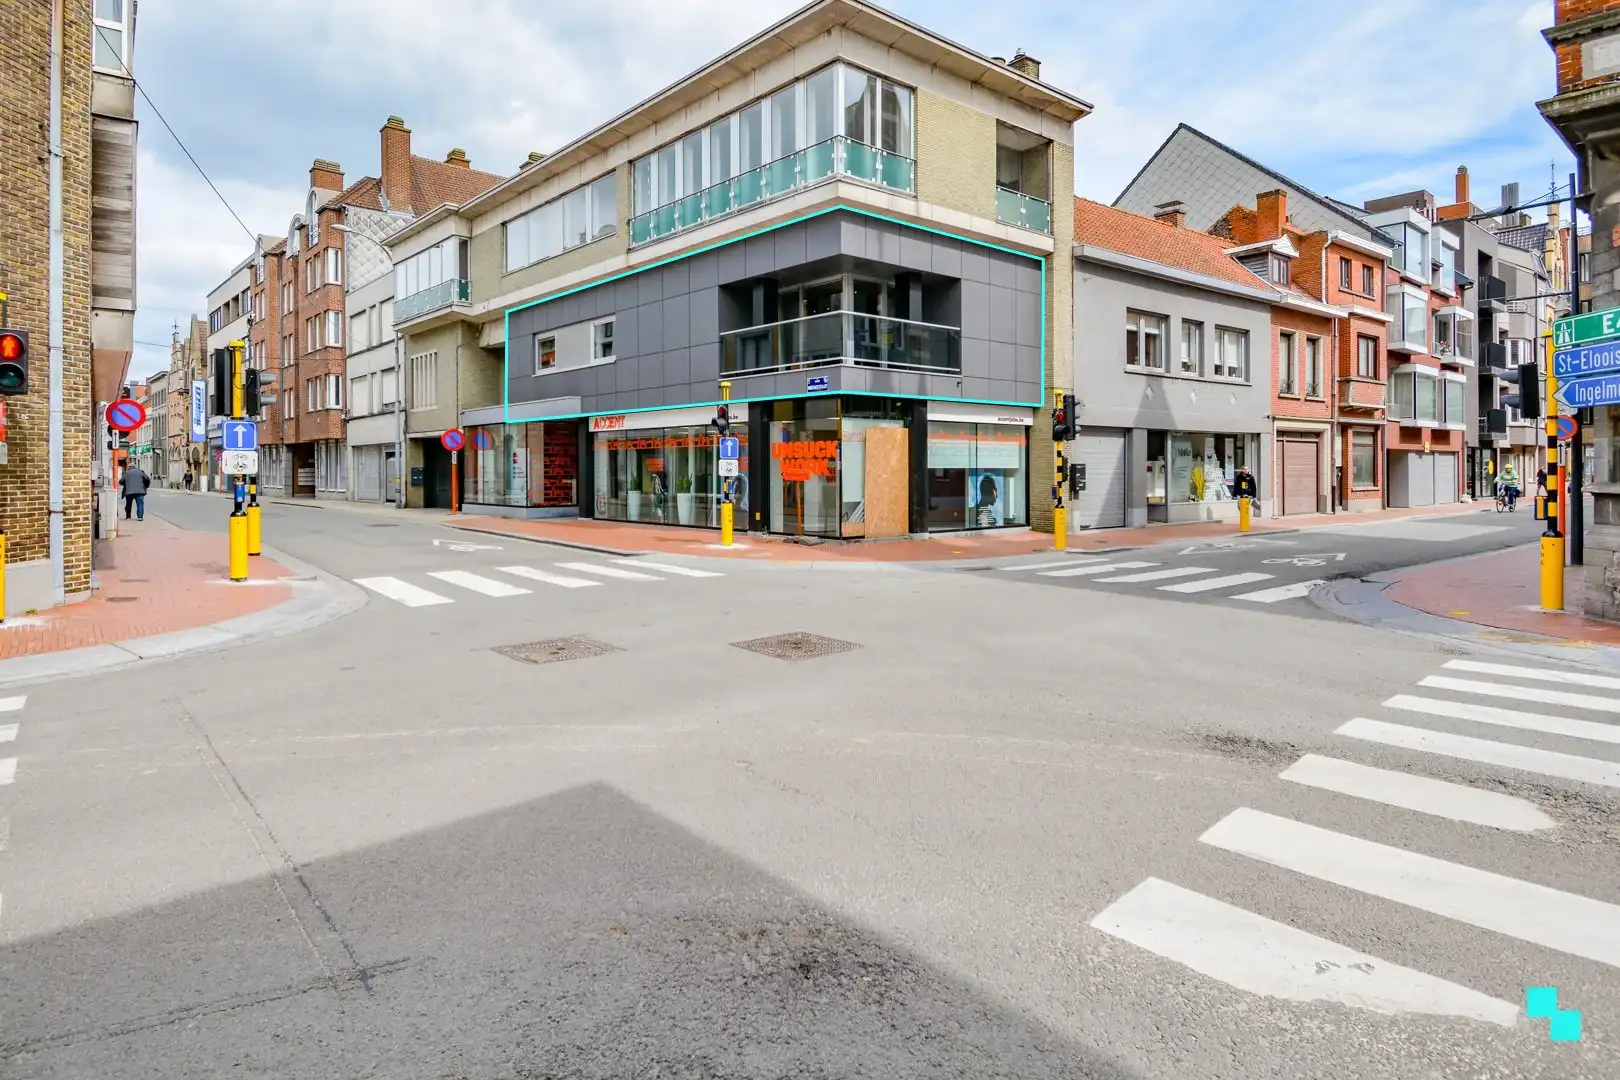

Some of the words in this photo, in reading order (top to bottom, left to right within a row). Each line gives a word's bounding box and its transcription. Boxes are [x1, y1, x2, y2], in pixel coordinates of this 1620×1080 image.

[1575, 381, 1620, 406] Ingelm
[593, 415, 625, 429] ACCENT
[772, 440, 838, 458] UNSUCK
